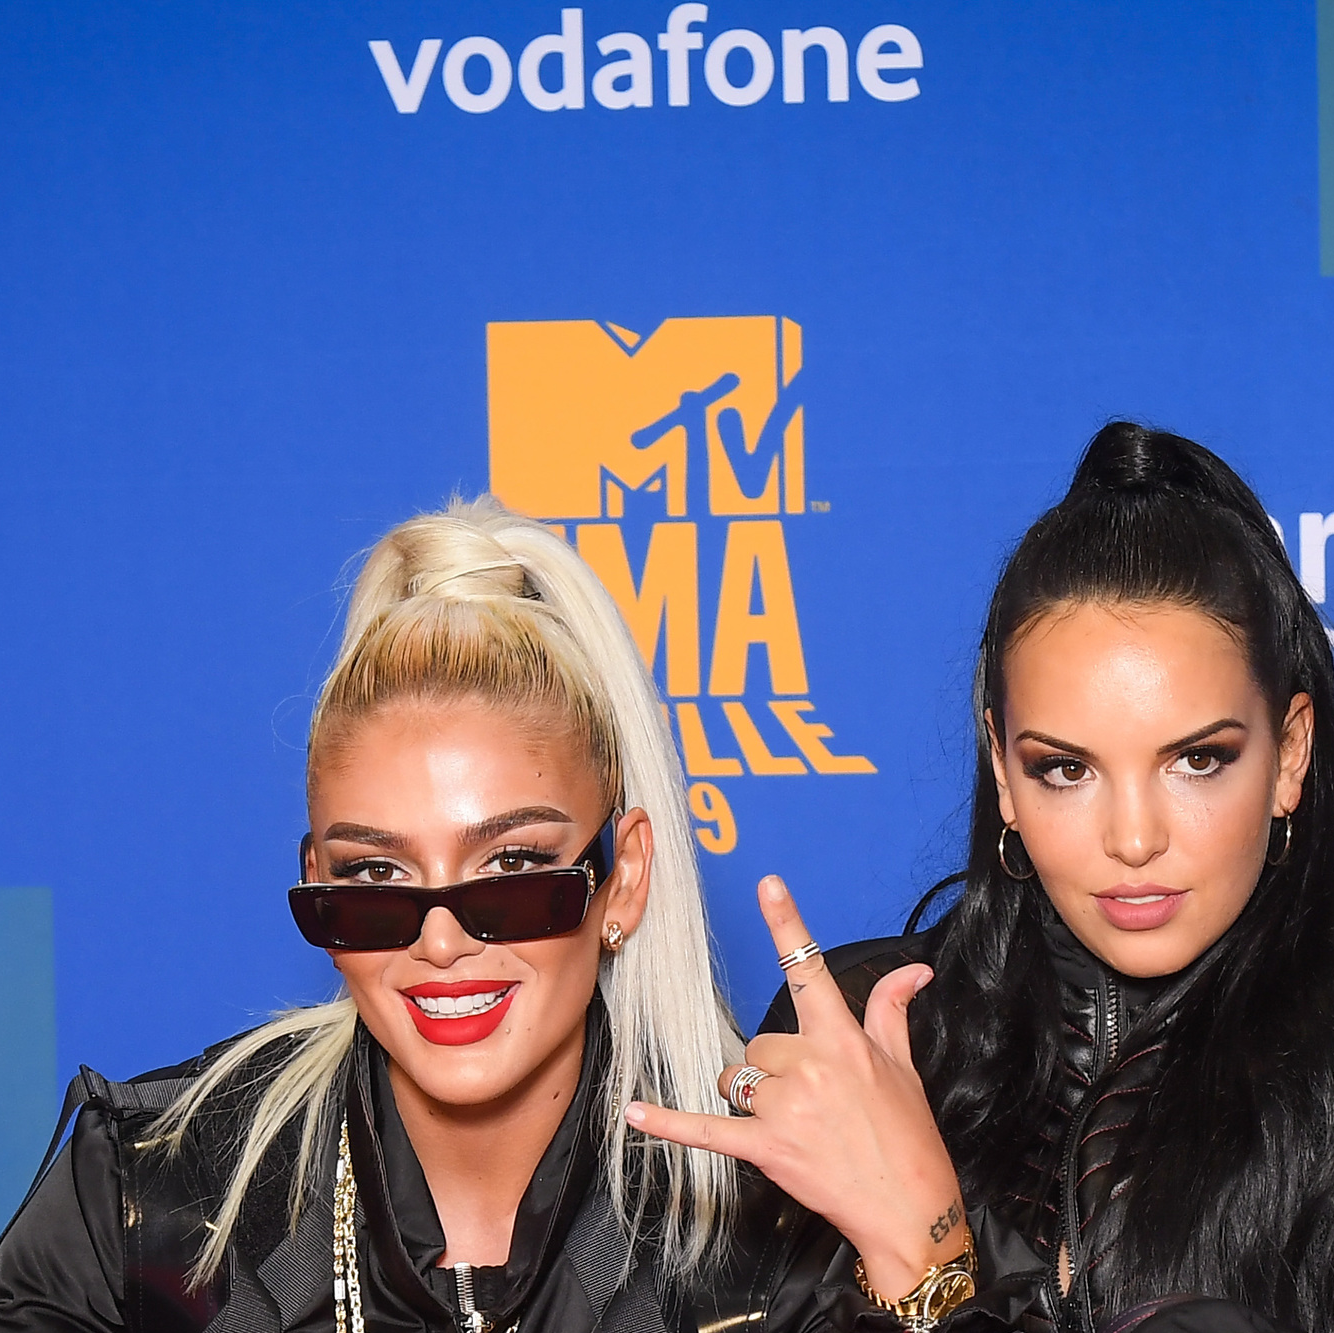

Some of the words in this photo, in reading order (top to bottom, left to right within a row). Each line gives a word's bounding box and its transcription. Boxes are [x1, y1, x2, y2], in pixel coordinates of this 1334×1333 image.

[368, 3, 924, 114] vodafone
[487, 315, 805, 519] MTV
[549, 520, 809, 697] MA
